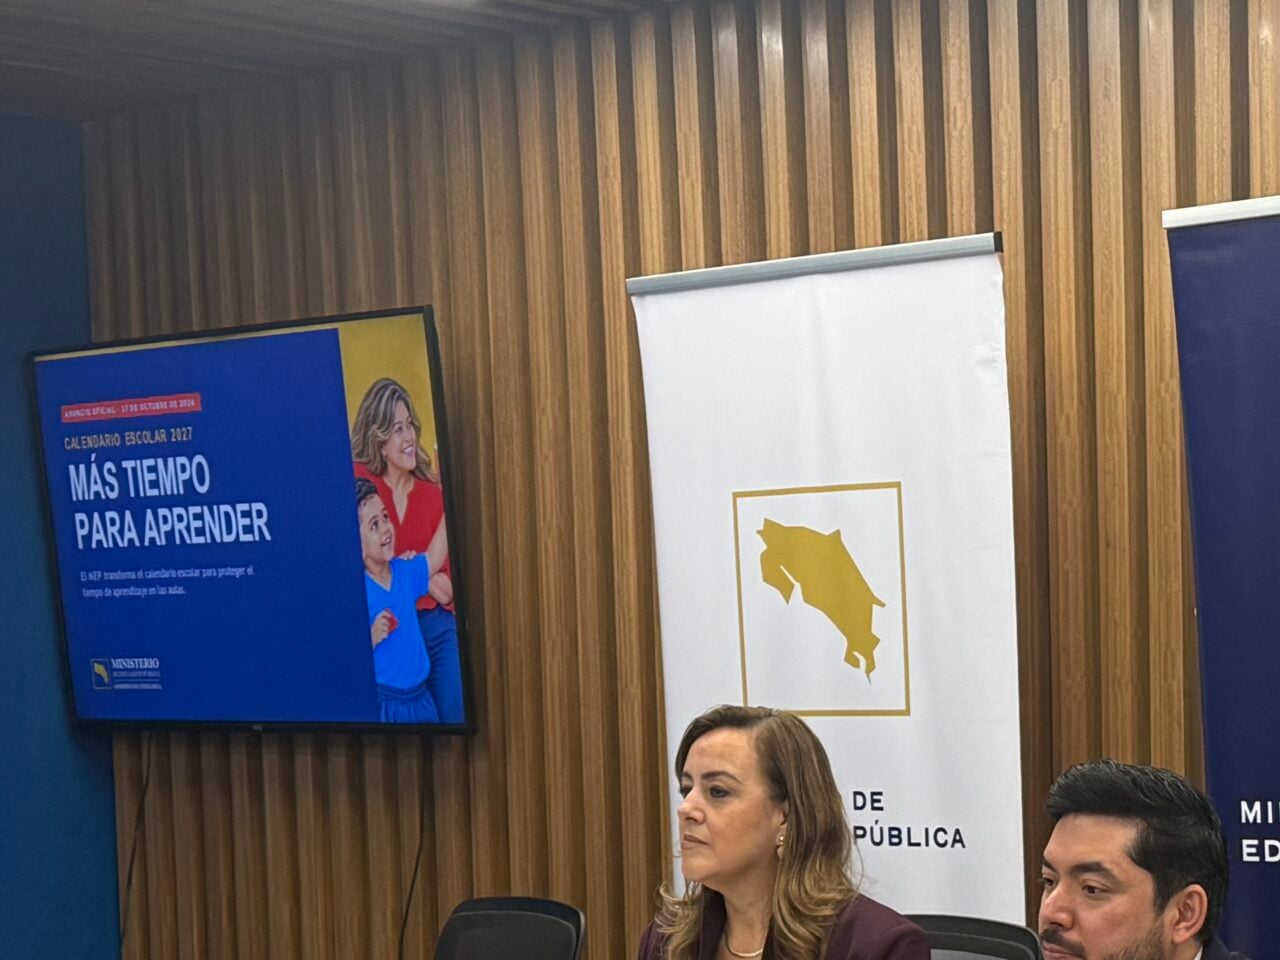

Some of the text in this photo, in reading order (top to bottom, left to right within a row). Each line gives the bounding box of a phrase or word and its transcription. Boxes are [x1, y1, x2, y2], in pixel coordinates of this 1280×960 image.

[64, 426, 193, 450] CALENDARIO ESCOLAR 2027
[68, 453, 210, 501] MÁS TIEMPO
[74, 502, 272, 549] PARA APRENDER
[144, 567, 177, 579] calendario
[177, 567, 200, 577] escolar
[202, 567, 217, 578] para
[217, 566, 246, 578] proteger
[246, 564, 254, 576] el
[82, 587, 104, 599] tiempo
[104, 586, 112, 597] de
[148, 586, 157, 596] en
[111, 657, 160, 669] MINISTERIO
[852, 790, 884, 811] DE
[852, 819, 966, 849] PÚBLICA
